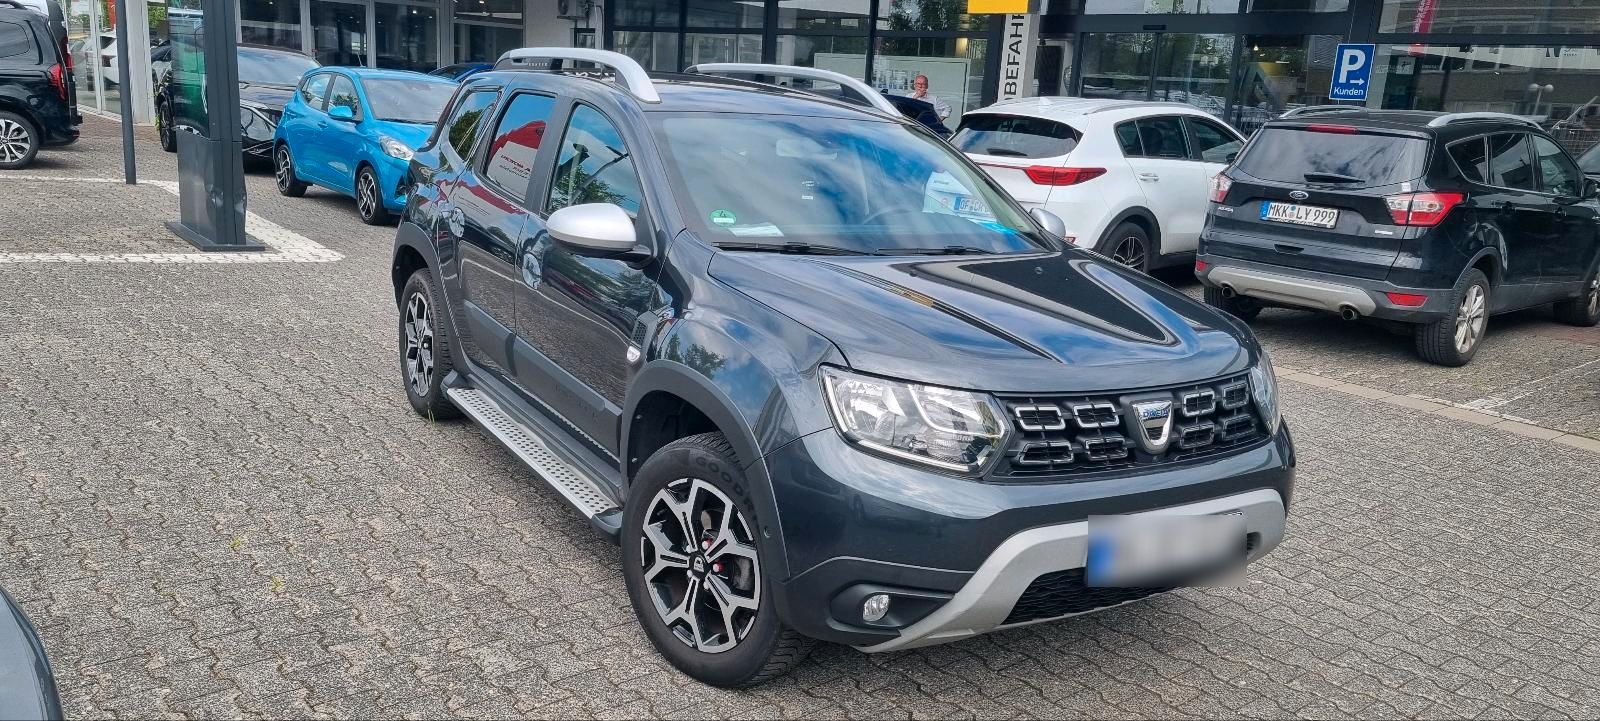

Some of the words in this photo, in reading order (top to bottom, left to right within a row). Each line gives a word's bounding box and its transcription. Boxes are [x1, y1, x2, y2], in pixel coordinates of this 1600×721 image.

[1003, 14, 1024, 100] BEFAH
[1339, 49, 1365, 83] P
[1333, 86, 1364, 96] Kunden
[1268, 204, 1289, 218] MKK
[1296, 207, 1311, 220] LY
[1313, 209, 1336, 223] 999
[1142, 409, 1169, 418] DACIA
